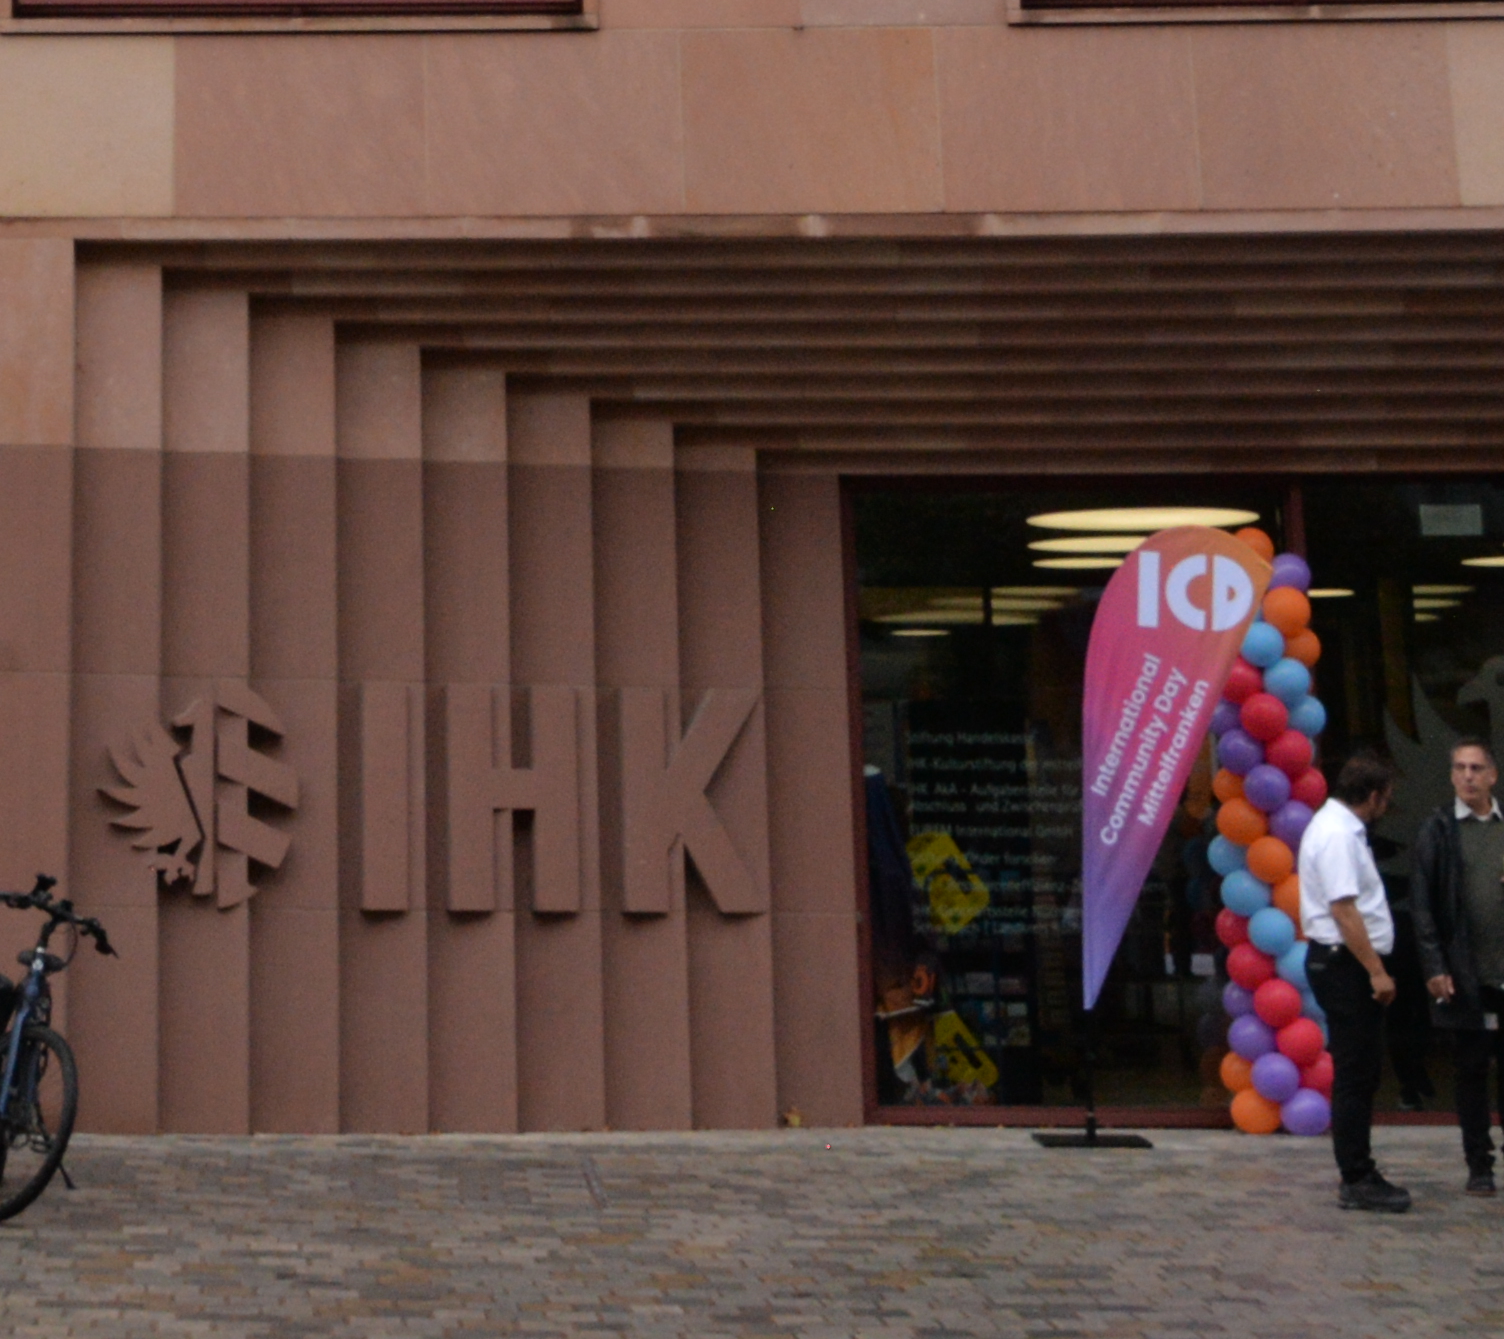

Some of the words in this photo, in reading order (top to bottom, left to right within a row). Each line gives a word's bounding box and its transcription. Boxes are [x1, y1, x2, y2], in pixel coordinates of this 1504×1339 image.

[1137, 549, 1254, 632] ICD
[1090, 652, 1161, 798] International
[1100, 714, 1170, 847] Community
[1153, 666, 1189, 715] Day
[1137, 678, 1211, 827] Mittelfranken
[360, 681, 768, 919] IHK
